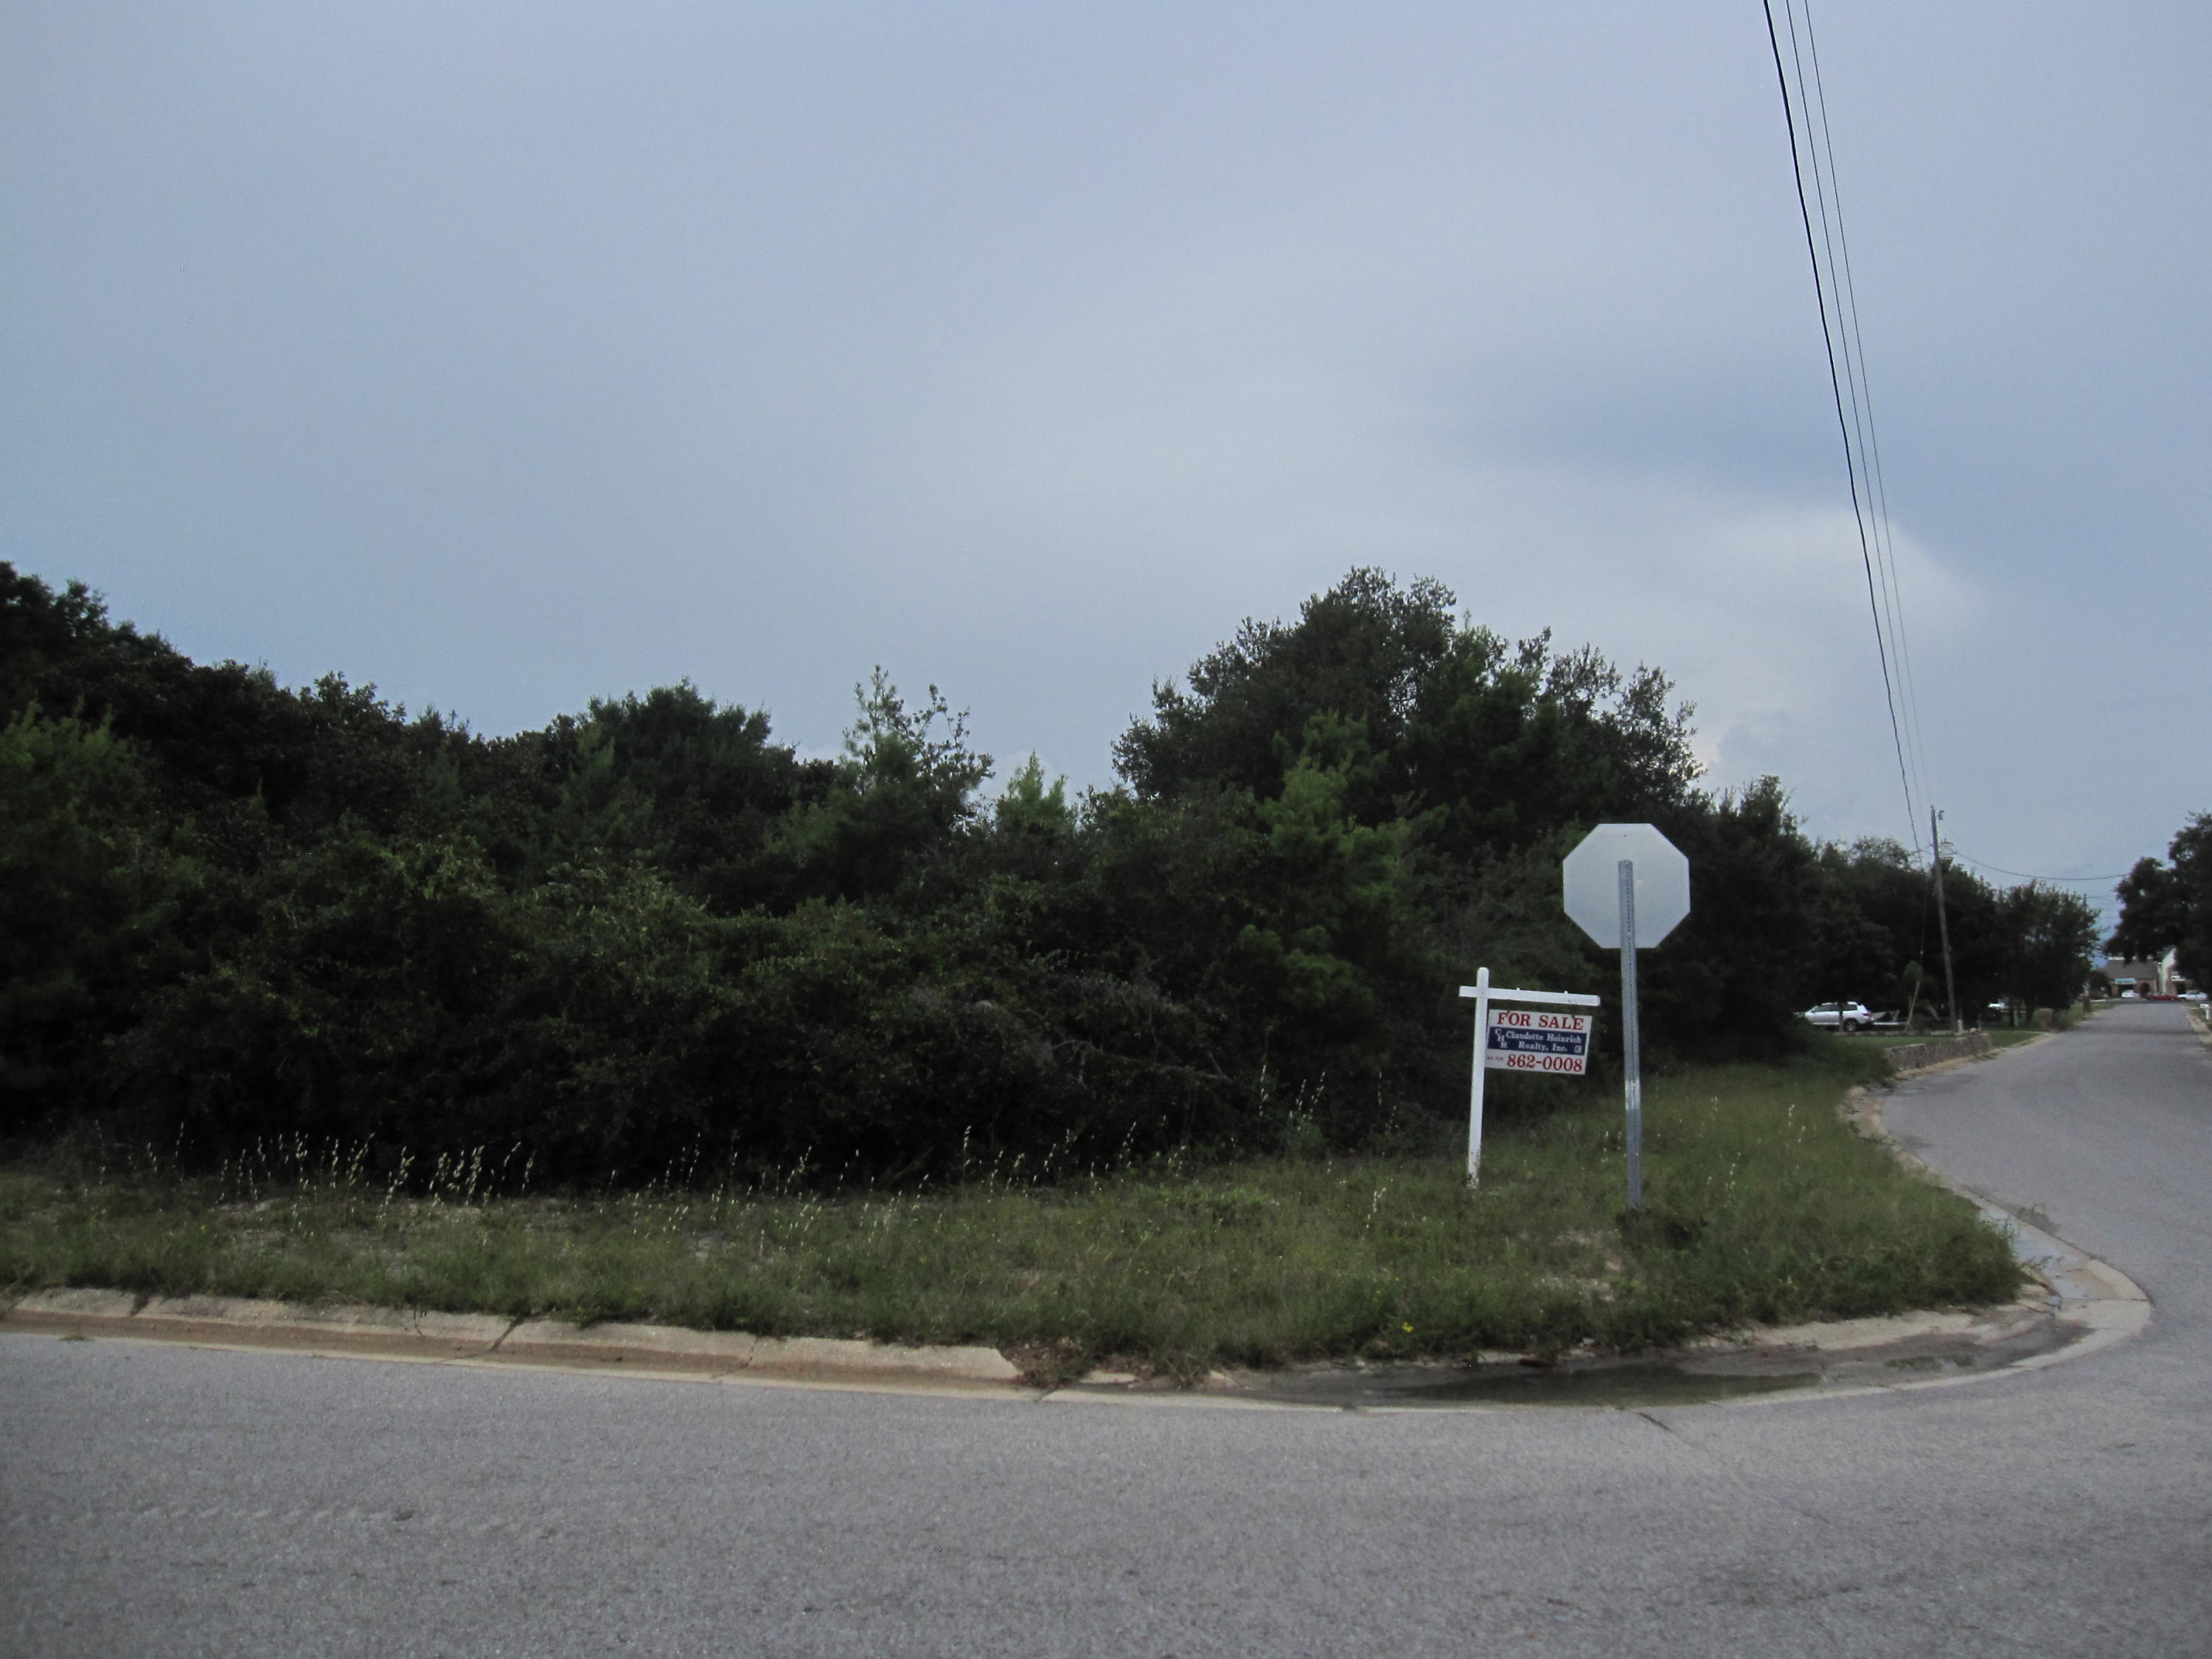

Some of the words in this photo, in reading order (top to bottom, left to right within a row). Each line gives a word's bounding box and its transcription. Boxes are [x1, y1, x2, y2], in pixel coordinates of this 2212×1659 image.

[1498, 1012, 1531, 1026] FOR
[1539, 1015, 1584, 1030] SALE
[1506, 1031, 1544, 1040] Claudette
[1547, 1033, 1582, 1043] Heinrich
[1507, 1054, 1582, 1072] 862-0008
